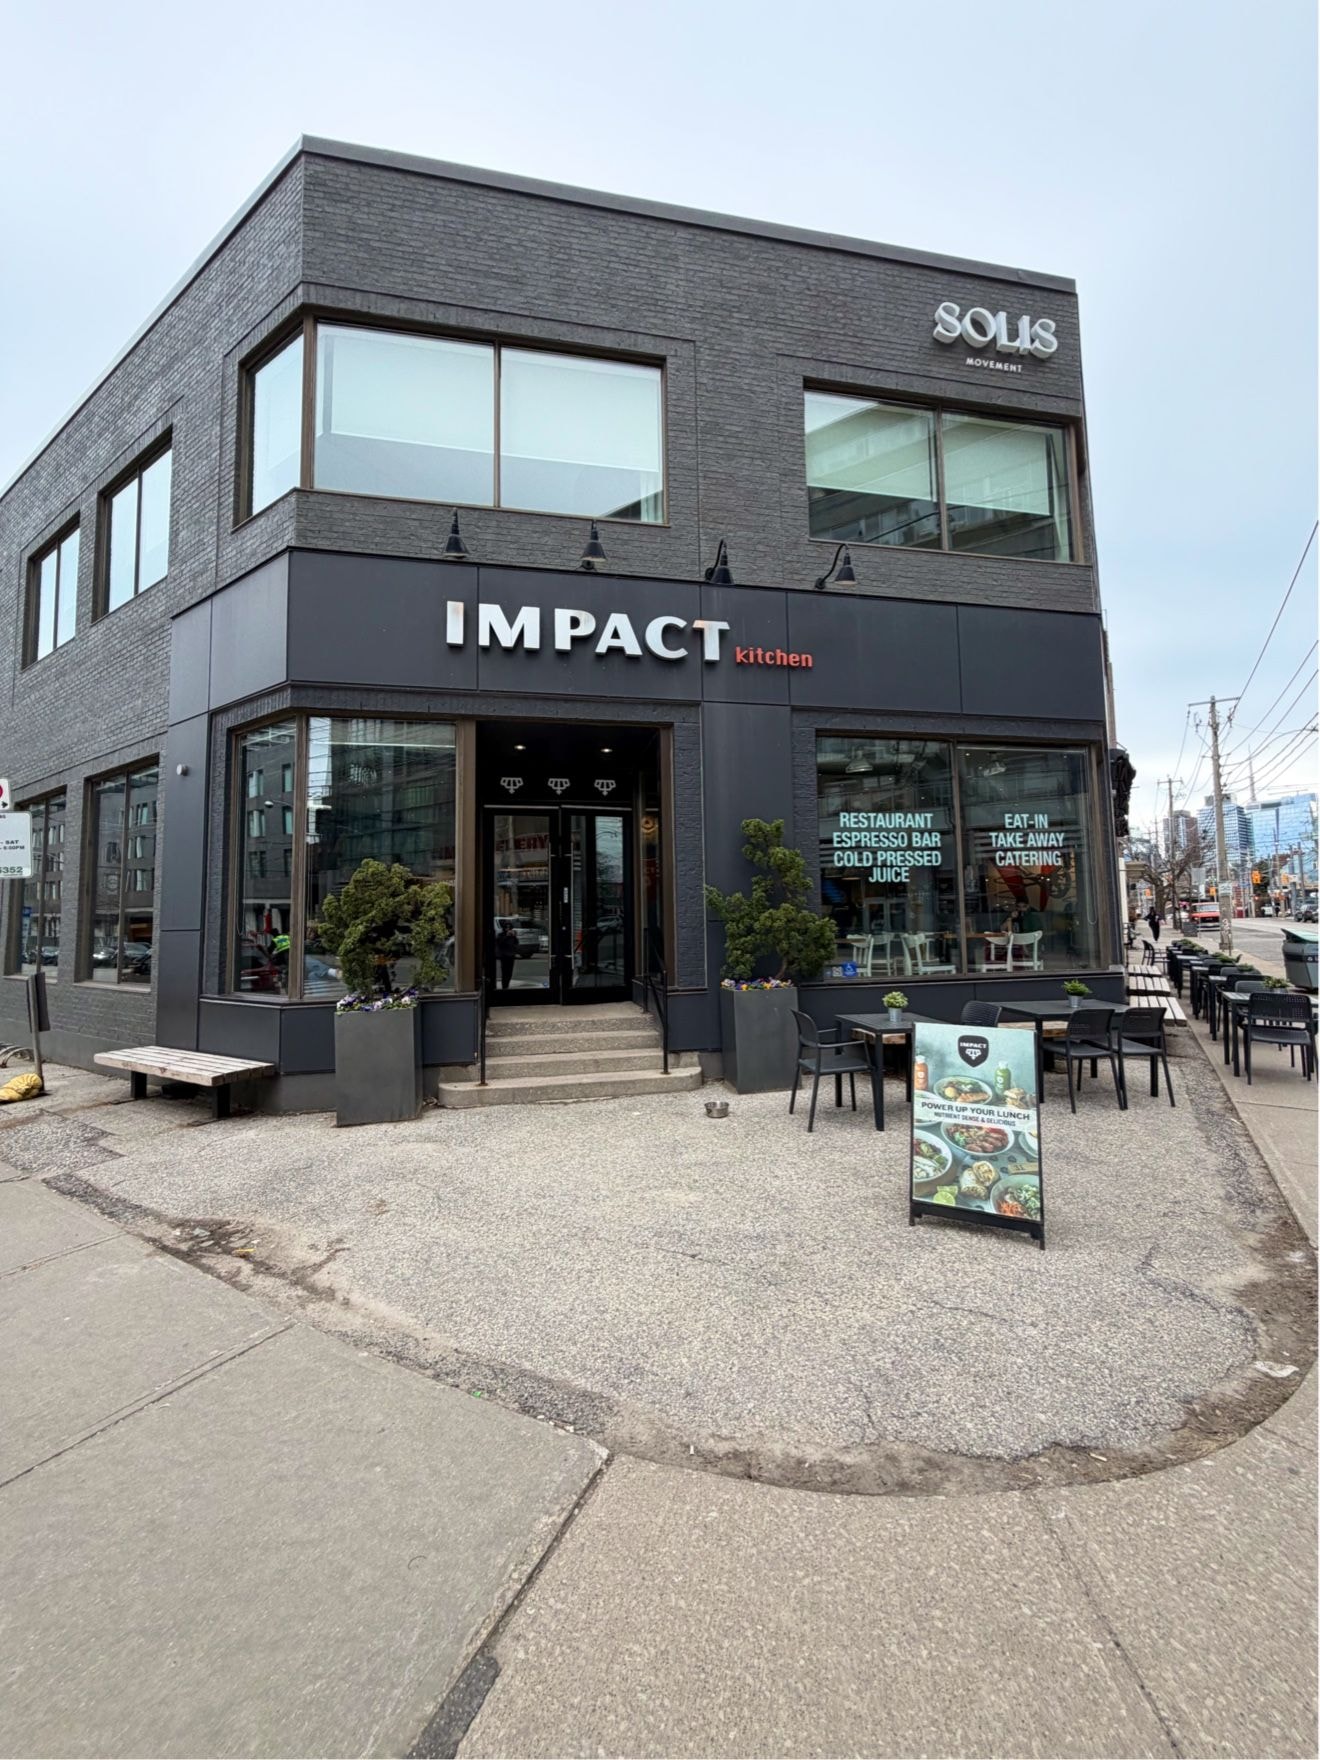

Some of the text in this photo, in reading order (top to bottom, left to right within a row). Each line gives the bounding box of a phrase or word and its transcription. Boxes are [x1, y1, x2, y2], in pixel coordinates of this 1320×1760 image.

[933, 302, 1058, 359] SOLIS
[965, 357, 1023, 373] MOVEMENT
[446, 600, 813, 668] IMPACT kitchen
[839, 812, 933, 828] RESTAURANT
[1004, 813, 1048, 829] EAT-IN
[832, 831, 941, 847] ESPRESSO BAR
[988, 832, 1065, 848] TAKE AWAY
[833, 850, 942, 867] COLD PRESSED
[995, 850, 1062, 866] CATERING
[868, 866, 910, 883] JUICE
[960, 1041, 987, 1049] IMPACT
[921, 1101, 1030, 1120] POWER UP YOUR LUNCH
[962, 1114, 980, 1122] DENSE
[987, 1117, 1016, 1127] DELICIOUS
